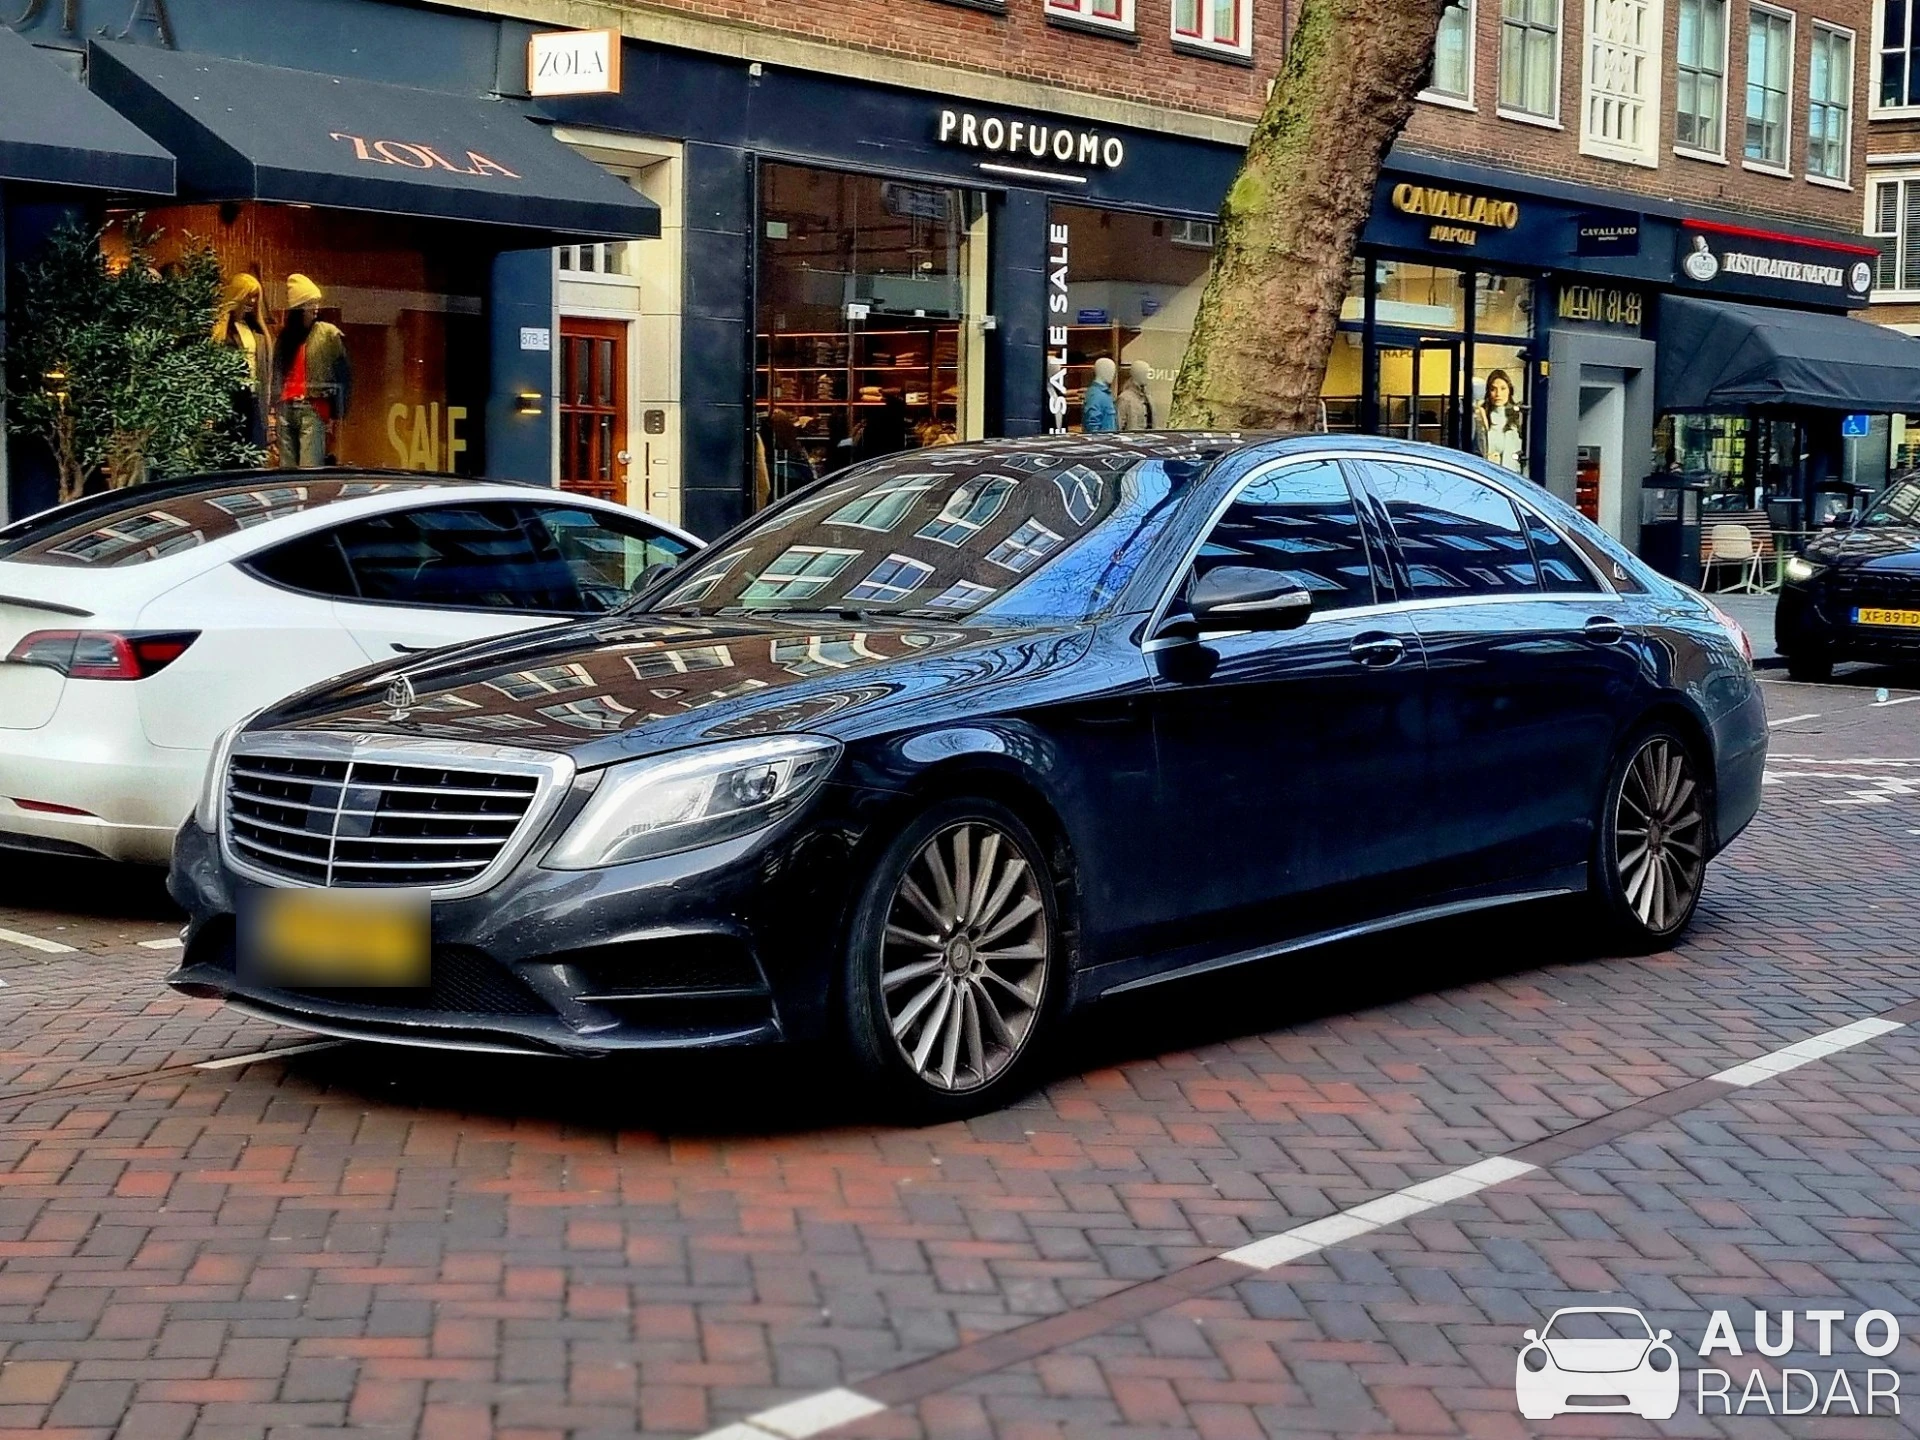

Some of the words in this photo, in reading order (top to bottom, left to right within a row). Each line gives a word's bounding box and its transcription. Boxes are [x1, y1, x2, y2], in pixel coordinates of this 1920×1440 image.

[538, 49, 604, 77] ZOLA
[329, 132, 522, 179] ZOLA
[939, 109, 1124, 168] PROFUOMO
[1392, 182, 1519, 230] CAVALLARO
[1429, 225, 1477, 246] NAPOLI
[1580, 227, 1637, 236] CAVALLARO
[1049, 223, 1068, 314] SALE
[1722, 252, 1801, 281] RISTORANTE
[1801, 264, 1844, 287] NAPOLI
[1559, 285, 1605, 321] MEENT
[1606, 289, 1643, 326] 81-83
[1049, 326, 1068, 415] SALE
